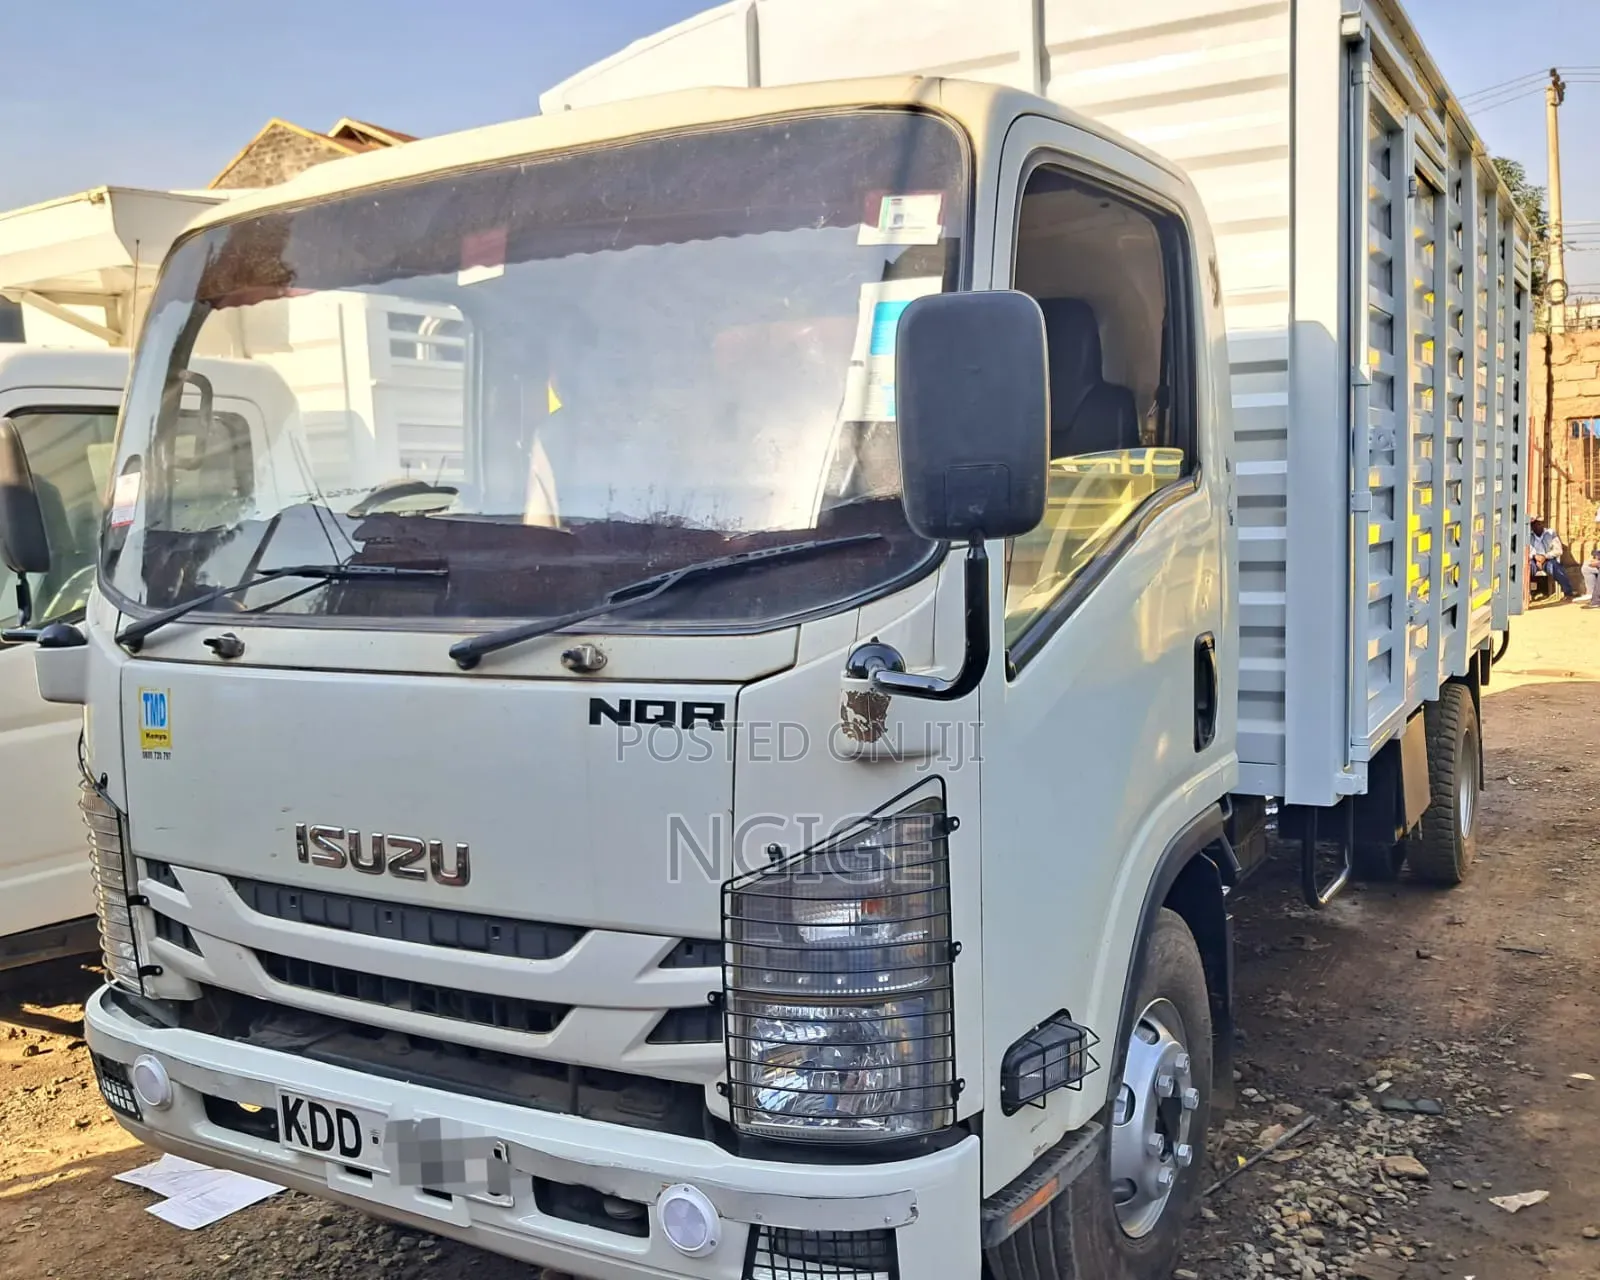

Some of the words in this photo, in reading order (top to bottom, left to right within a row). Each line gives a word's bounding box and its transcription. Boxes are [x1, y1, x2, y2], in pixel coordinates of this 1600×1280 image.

[589, 698, 725, 731] NQR
[296, 822, 471, 887] ISUZU
[281, 1095, 362, 1158] KDD
